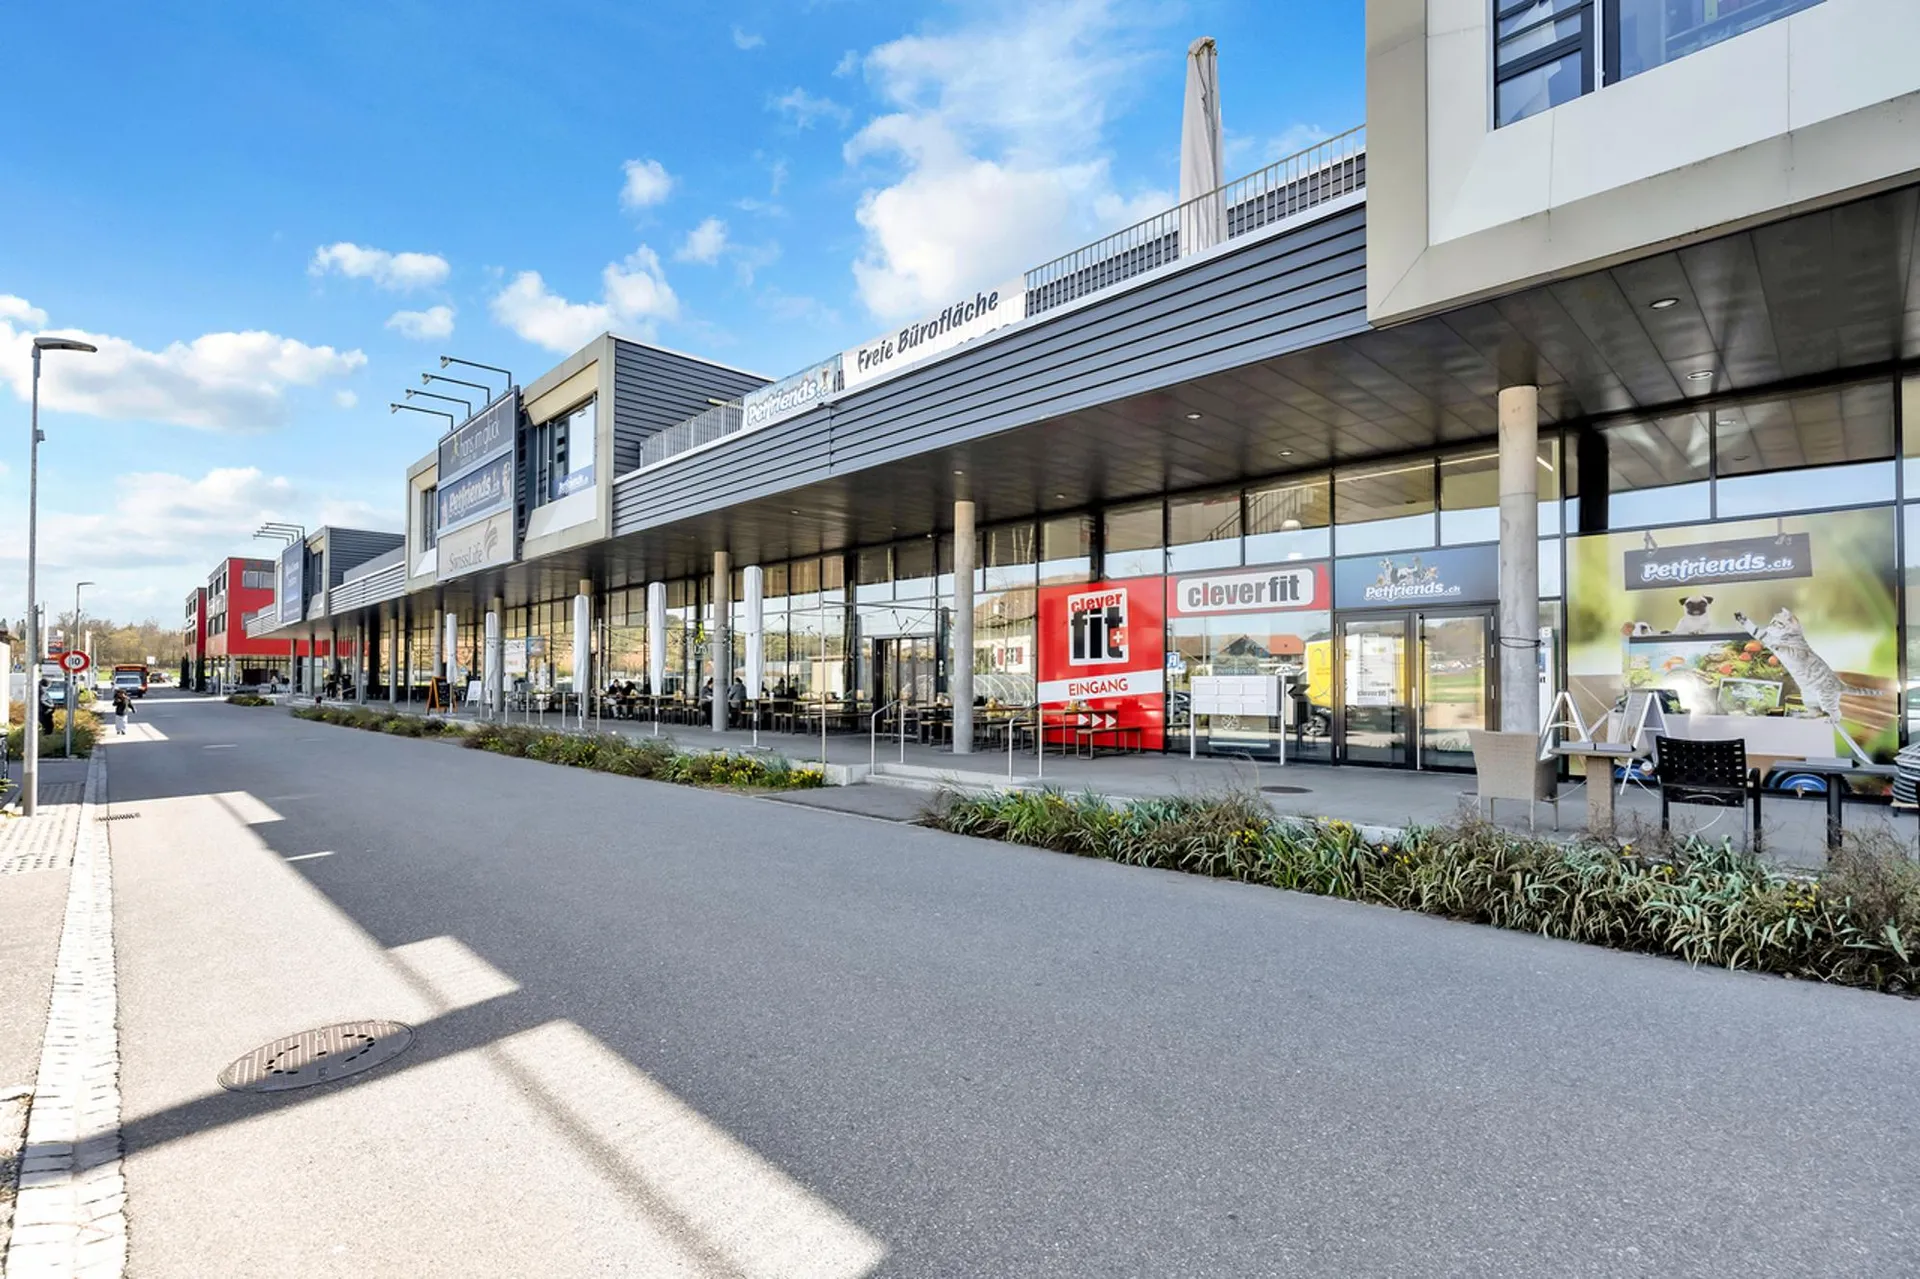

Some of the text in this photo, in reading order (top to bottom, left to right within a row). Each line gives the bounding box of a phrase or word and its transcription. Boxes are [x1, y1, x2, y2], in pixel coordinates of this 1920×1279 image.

[858, 340, 893, 373] Freie
[898, 291, 998, 354] Bürofläche
[1640, 553, 1794, 581] Petfriends.ch
[1071, 593, 1123, 613] clever
[1364, 581, 1462, 601] Petfriends.ch
[1071, 607, 1123, 659] fit
[1069, 678, 1129, 697] EINGANG
